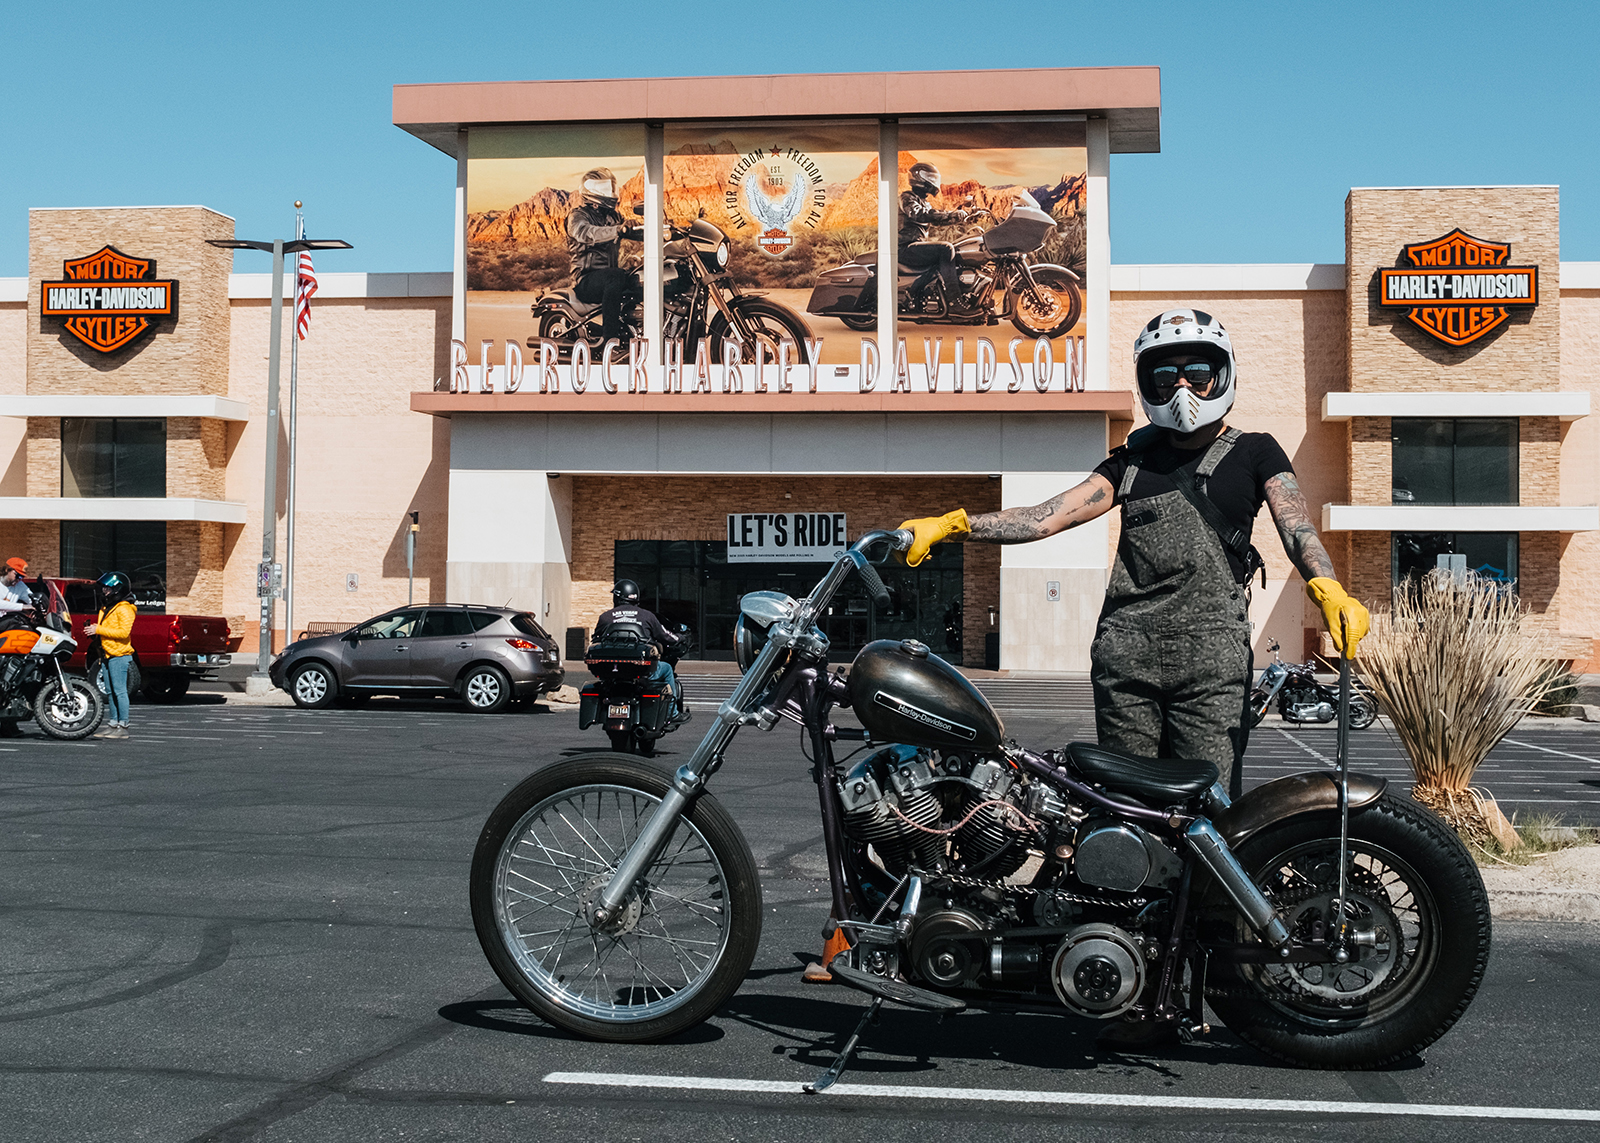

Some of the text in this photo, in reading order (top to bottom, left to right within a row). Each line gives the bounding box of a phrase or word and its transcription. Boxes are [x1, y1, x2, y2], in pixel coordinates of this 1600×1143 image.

[726, 148, 765, 230] ALL FOR FREEDOM
[768, 178, 783, 186] 1903
[786, 148, 826, 229] FREEDOM FOR ALL
[1421, 238, 1495, 266] MOTOR
[76, 254, 138, 279] MOTOR
[49, 287, 166, 310] HARLEY-DAVIDSON
[1388, 274, 1529, 299] HARLEY-DAVIDSON
[76, 317, 137, 346] CYCLES
[1422, 307, 1495, 339] CYCLES
[450, 335, 1085, 394] RED ROCK HARLEY-DAVIDSON
[729, 514, 845, 547] LET'S RIDE
[898, 704, 952, 731] Harley-Davidson
